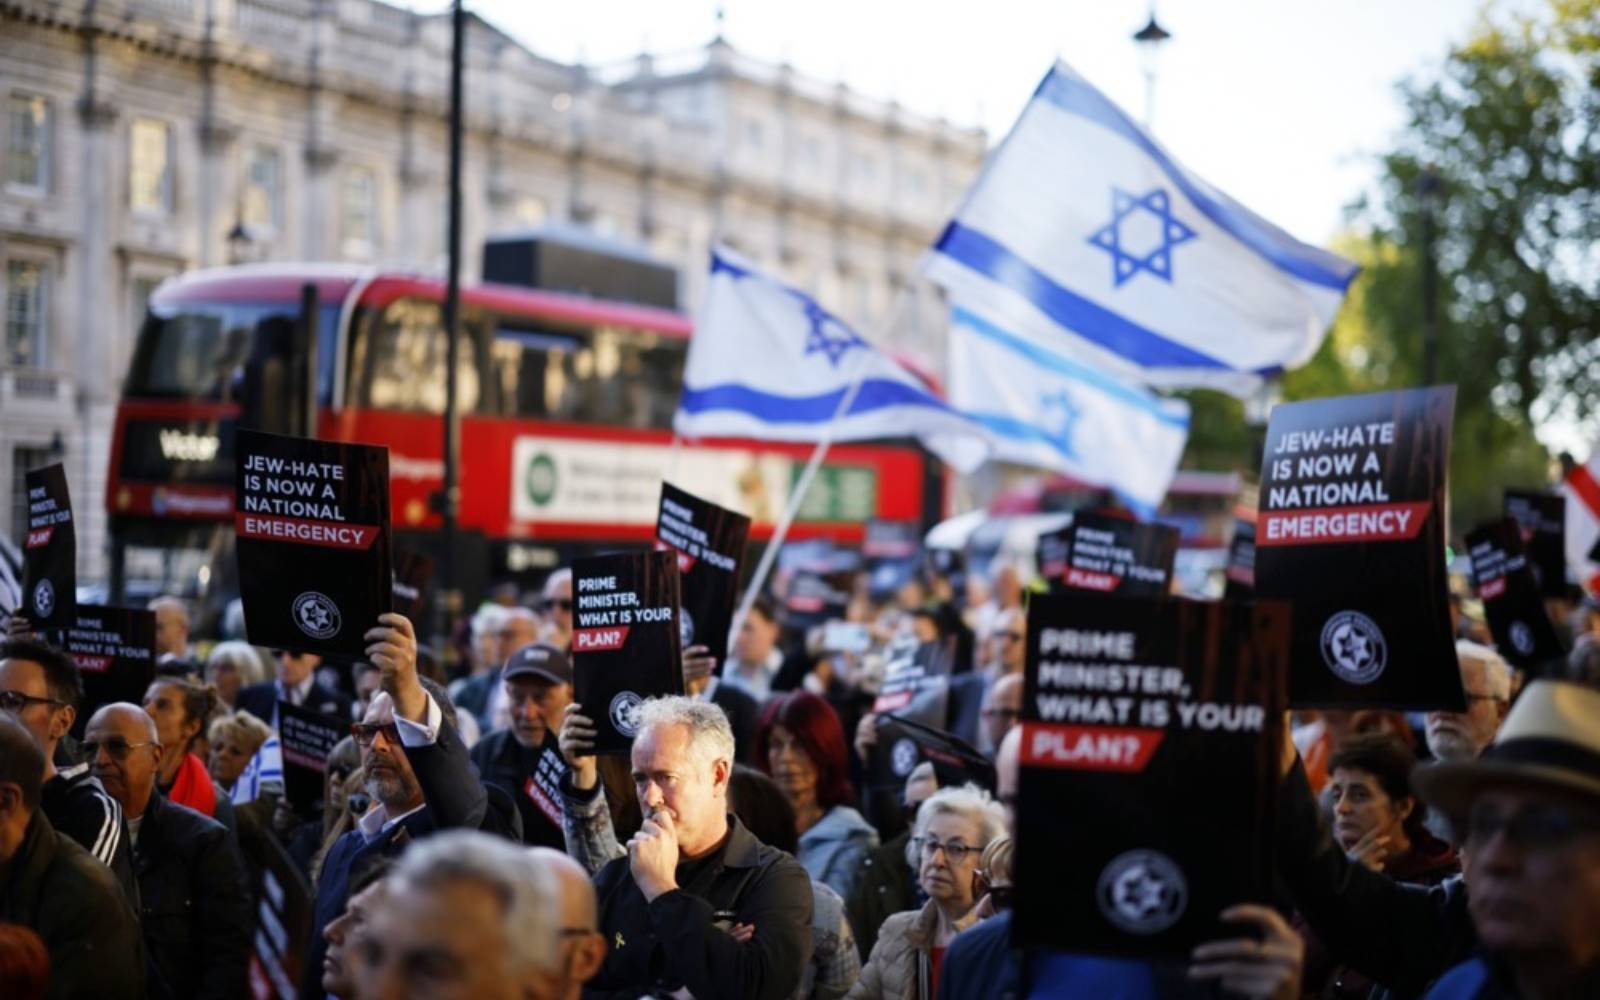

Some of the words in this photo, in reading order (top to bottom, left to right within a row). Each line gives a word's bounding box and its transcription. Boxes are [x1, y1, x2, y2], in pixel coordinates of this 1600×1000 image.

[1275, 422, 1395, 453] JEW-HATE
[244, 455, 344, 480] JEW-HATE
[1272, 459, 1292, 481] IS
[1298, 453, 1357, 478] NOW
[1362, 451, 1380, 473] A
[244, 475, 260, 490] IS
[266, 478, 315, 497] NOW
[321, 483, 335, 499] A
[1269, 480, 1389, 509] NATIONAL
[245, 496, 345, 521] NATIONAL
[245, 518, 364, 544] EMERGENCY
[1267, 510, 1412, 540] EMERGENCY
[579, 576, 616, 592] PRIME
[579, 592, 640, 609] MINISTER,
[77, 618, 102, 629] RIME
[579, 611, 617, 626] WHAT
[620, 610, 632, 624] IS
[634, 607, 672, 623] YOUR
[578, 631, 621, 647] PLAN?
[1040, 628, 1136, 659] PRIME
[1038, 662, 1191, 697] MINISTER,
[1036, 694, 1133, 725] WHAT
[1140, 700, 1169, 728] IS
[1176, 701, 1265, 731] YOUR
[1033, 731, 1141, 765] PLAN?
